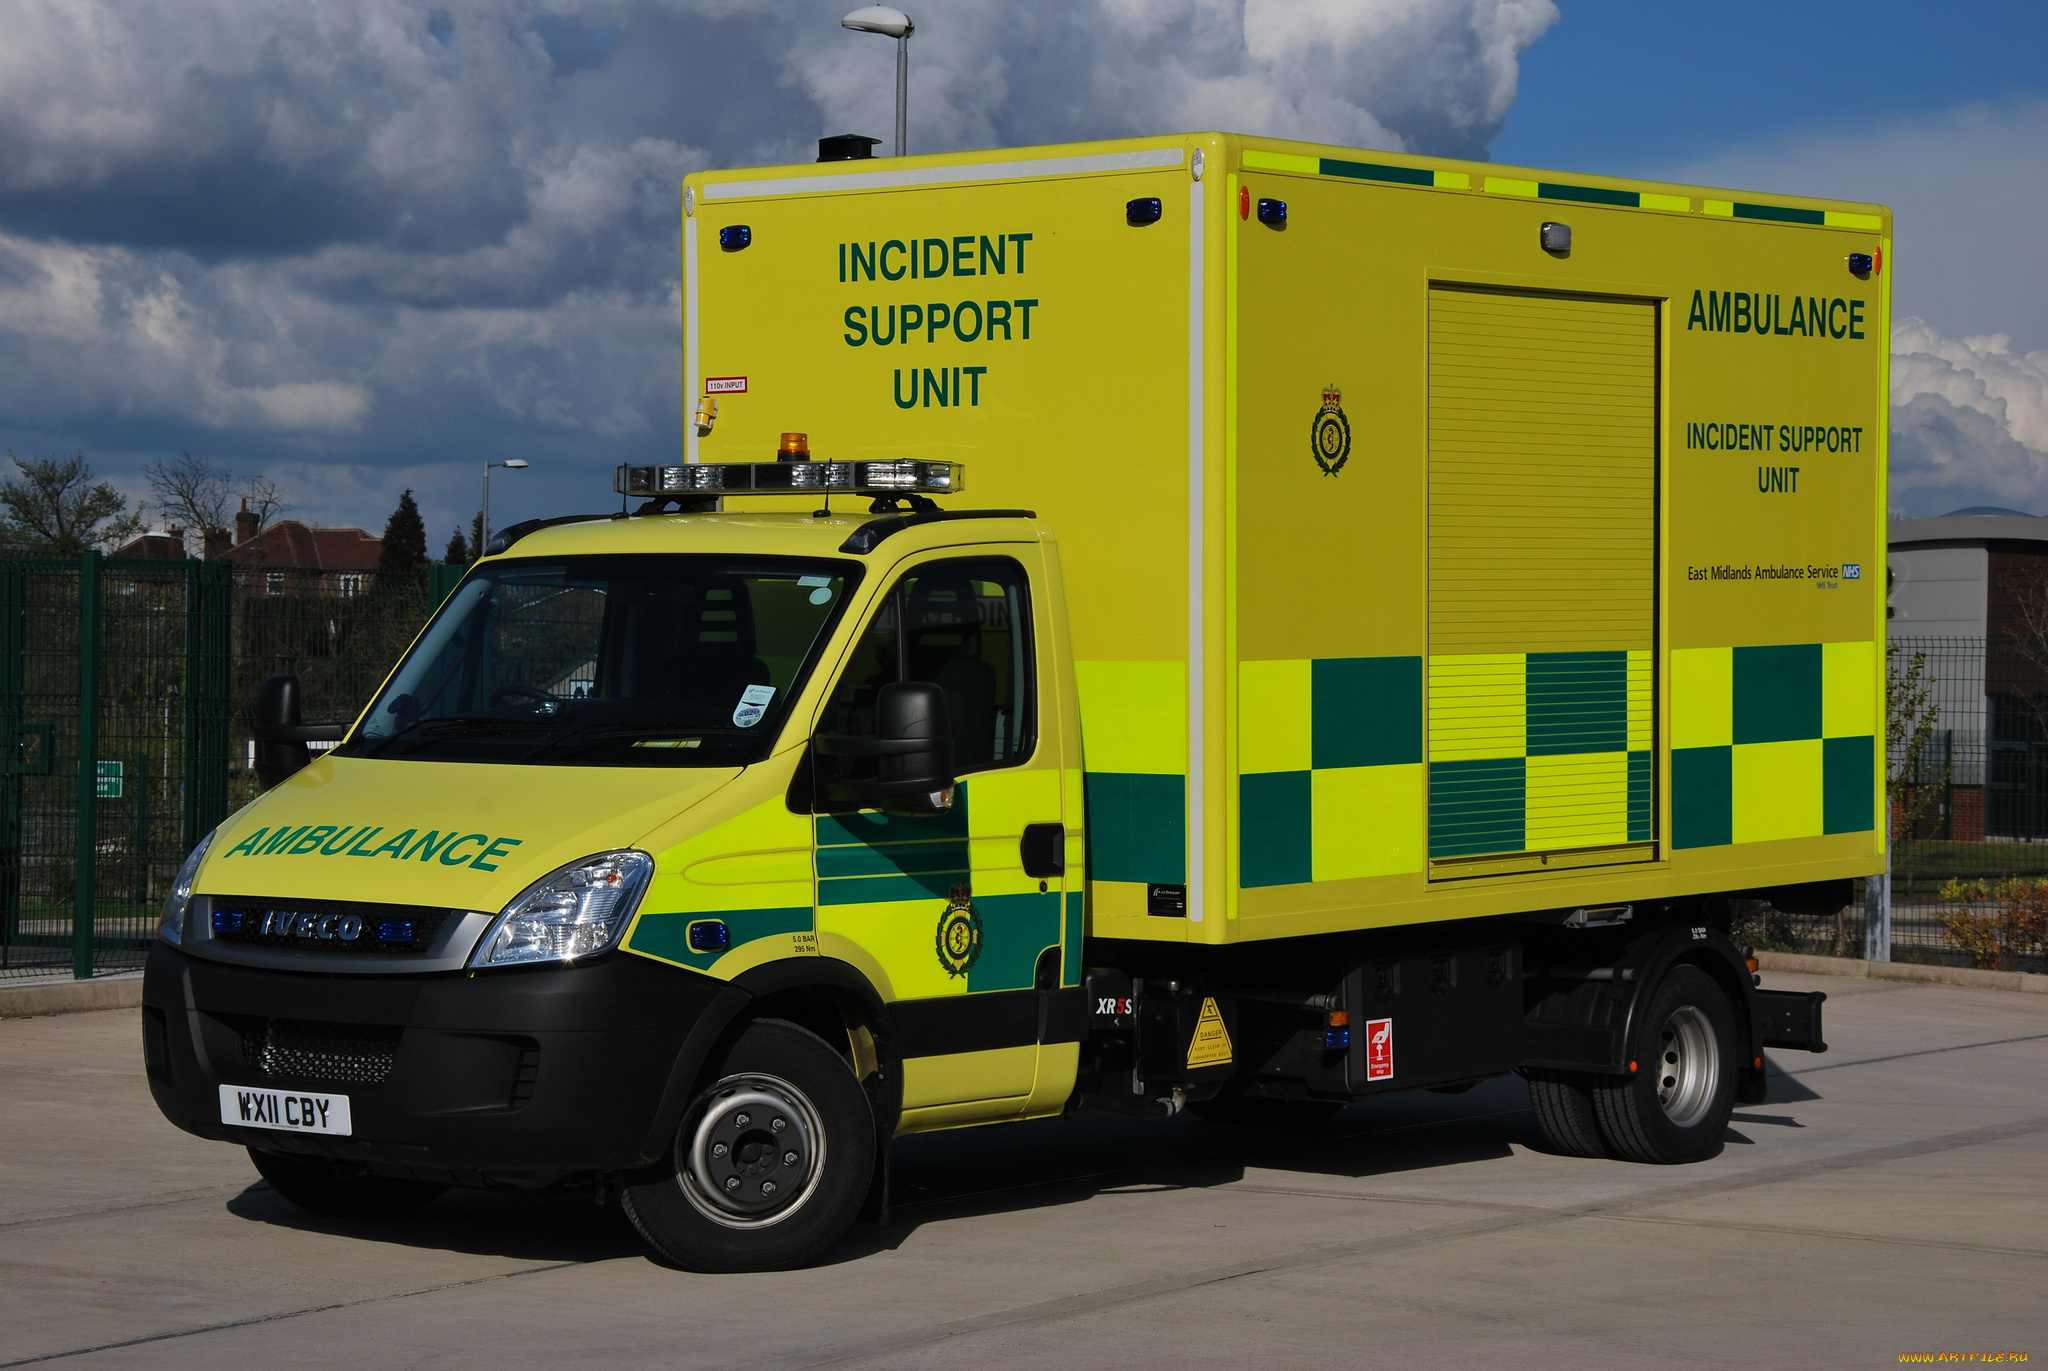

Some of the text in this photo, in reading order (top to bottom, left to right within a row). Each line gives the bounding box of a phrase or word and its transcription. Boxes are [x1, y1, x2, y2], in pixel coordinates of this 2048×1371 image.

[839, 232, 1034, 283] INCIDENT
[843, 298, 1039, 348] SUPPORT
[1687, 289, 1865, 340] AMBULANCE
[893, 366, 988, 410] UNIT
[1687, 422, 1864, 453] INCIDENT SUPPORT
[1758, 466, 1800, 494] UNIT
[1688, 564, 1860, 581] East Midlands Ambulance Service NHS
[222, 825, 524, 872] AMBULANCE
[260, 910, 363, 941] IVECO
[802, 935, 815, 943] BAR
[1095, 997, 1132, 1015] XR5S
[1200, 1030, 1222, 1039] DANGER
[237, 1091, 330, 1128] WX11 CBY
